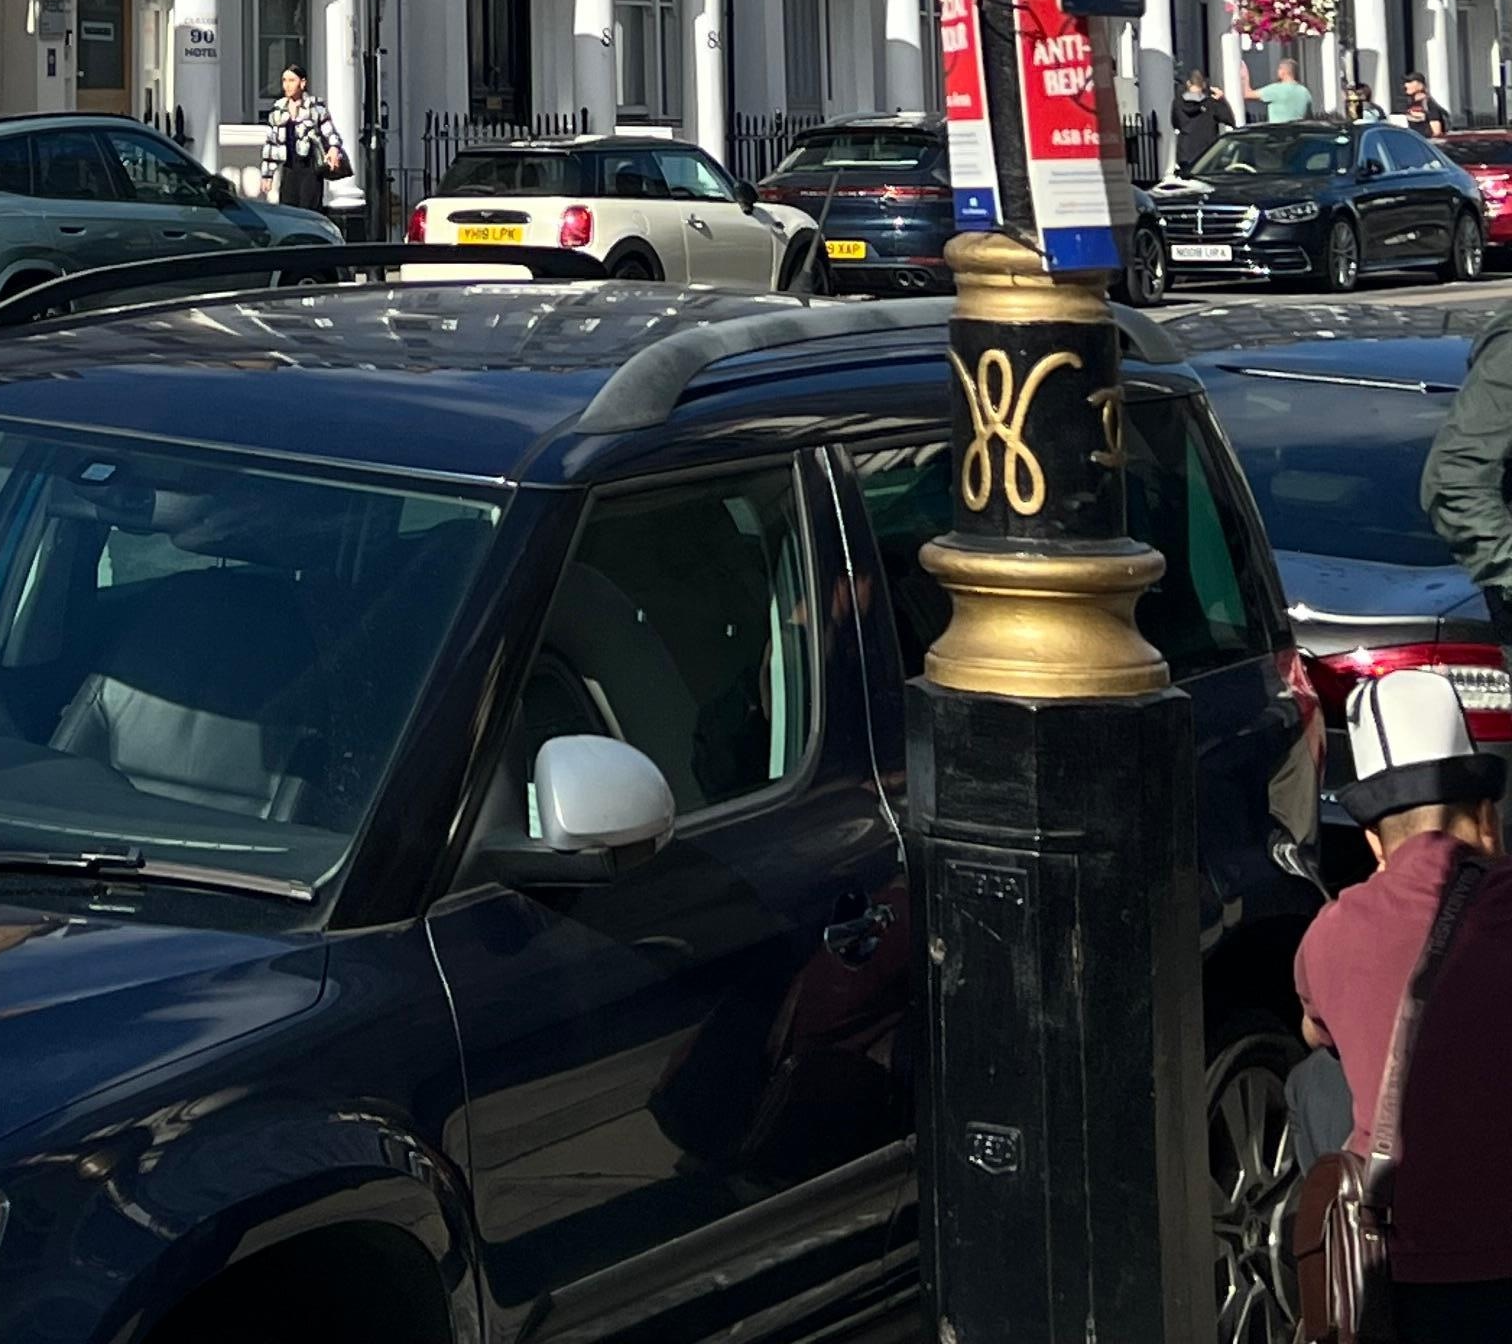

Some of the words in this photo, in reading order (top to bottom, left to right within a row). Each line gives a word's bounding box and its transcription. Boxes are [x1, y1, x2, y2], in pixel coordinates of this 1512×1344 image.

[190, 29, 215, 44] 90
[185, 48, 218, 58] HOTEL
[1033, 34, 1091, 65] ANTI-
